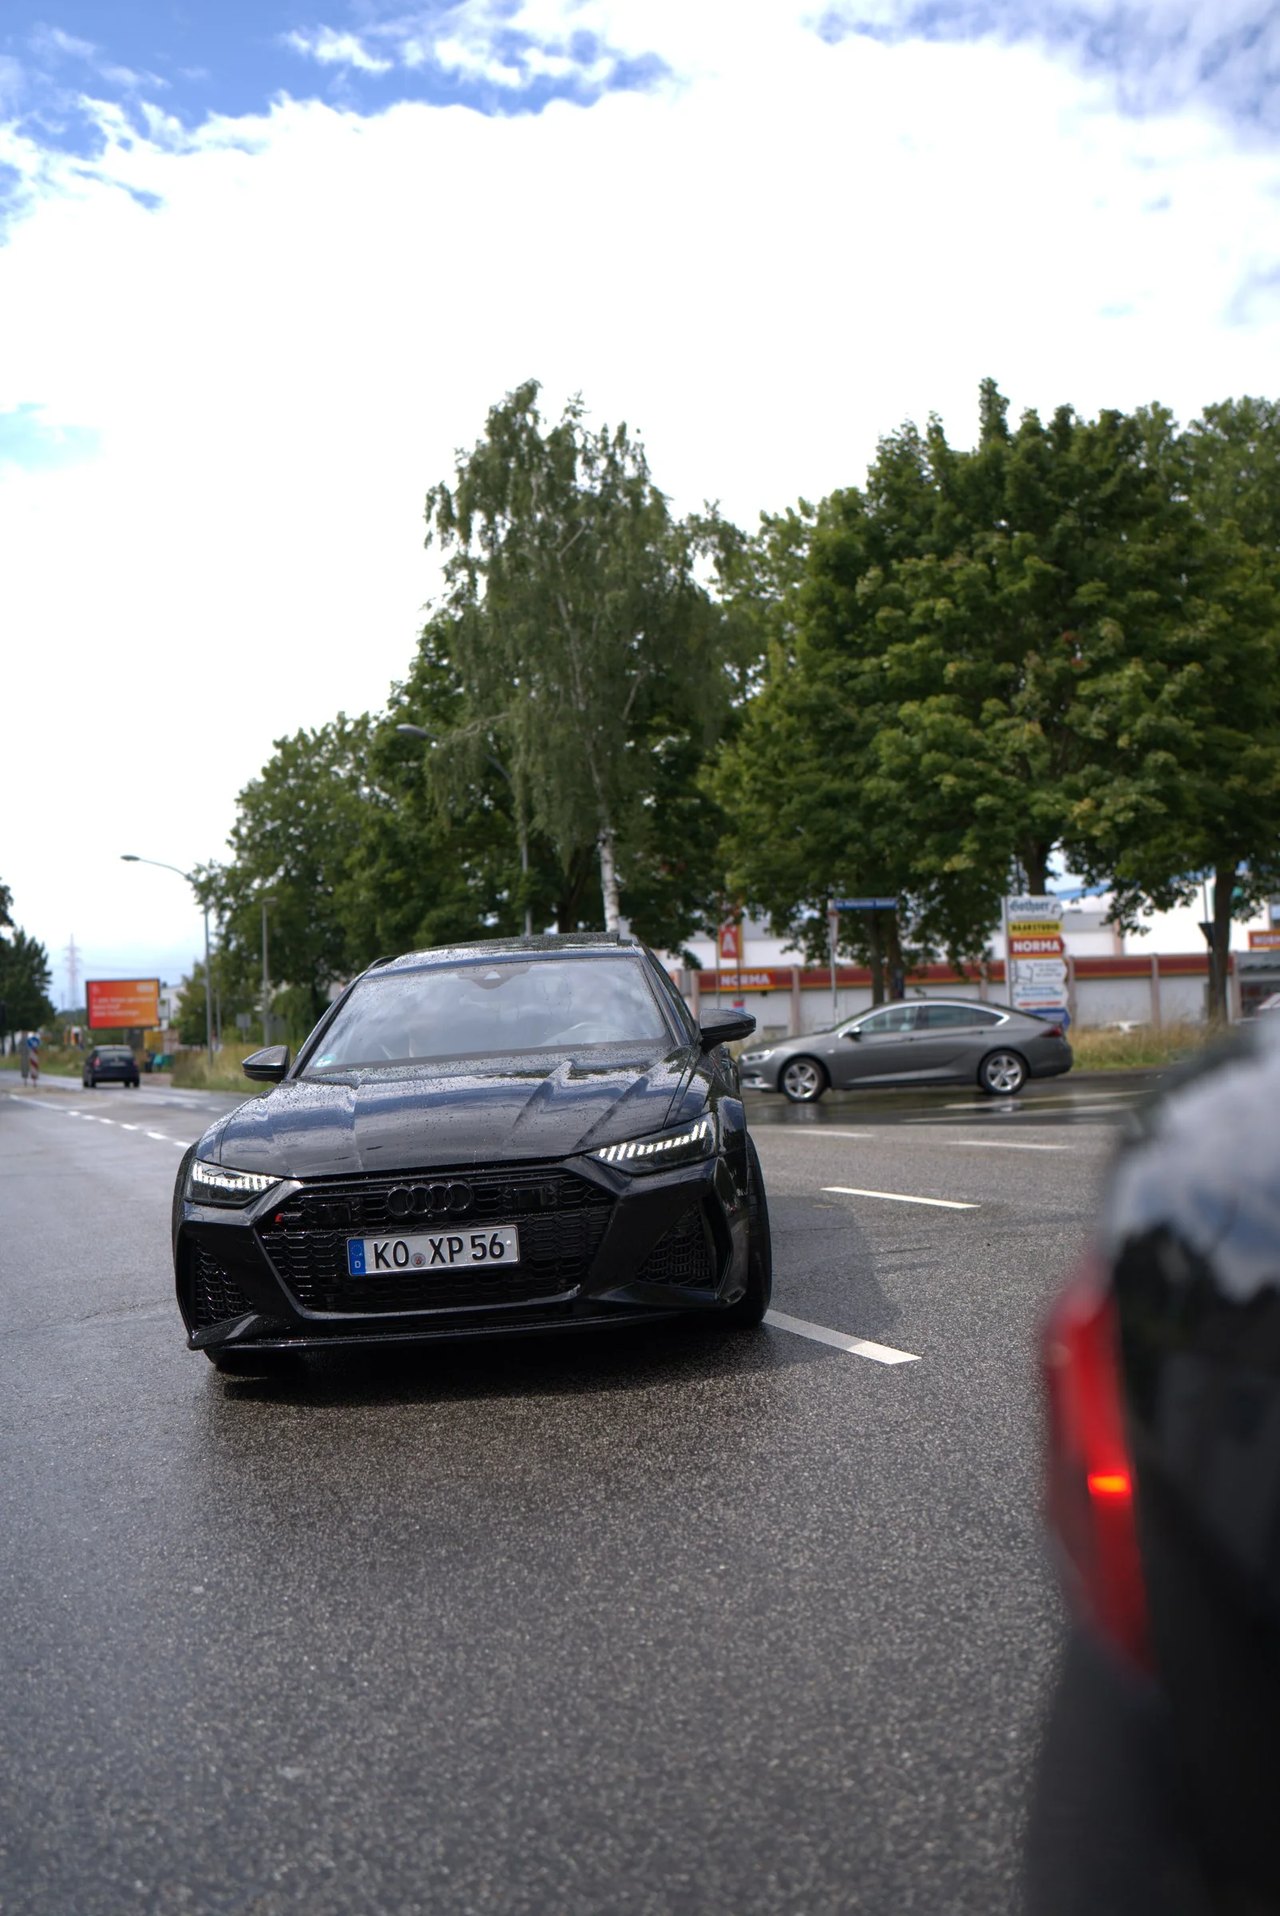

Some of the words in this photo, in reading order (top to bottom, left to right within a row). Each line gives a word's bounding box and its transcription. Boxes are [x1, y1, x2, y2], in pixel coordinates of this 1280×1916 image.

[1013, 940, 1060, 953] NORMA
[720, 973, 770, 987] NORMA
[373, 1240, 410, 1269] KO
[428, 1236, 464, 1265] XP
[470, 1233, 505, 1262] 56
[354, 1260, 361, 1269] D
